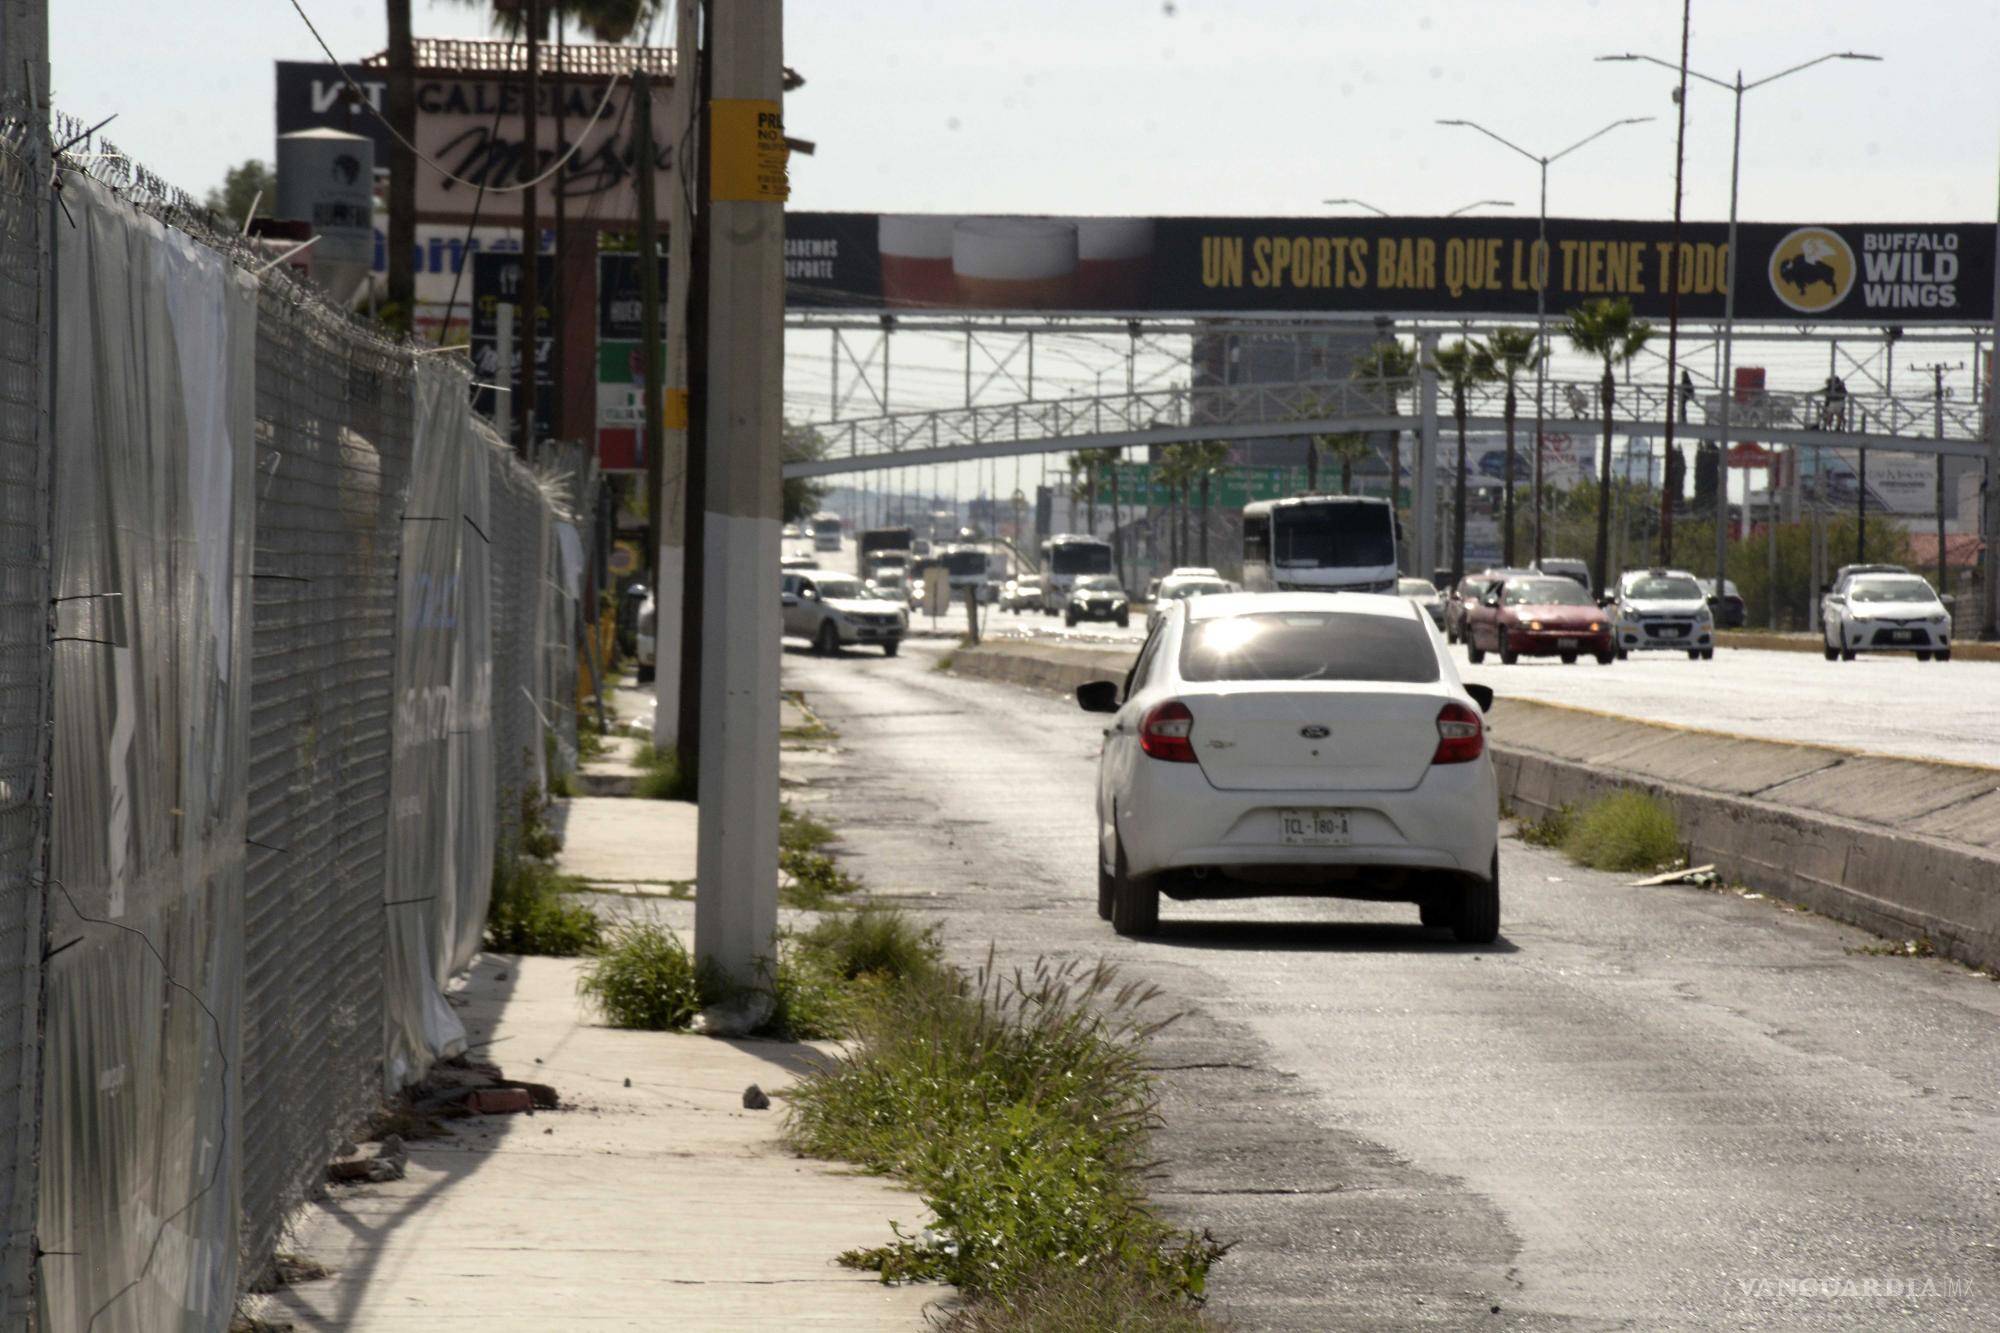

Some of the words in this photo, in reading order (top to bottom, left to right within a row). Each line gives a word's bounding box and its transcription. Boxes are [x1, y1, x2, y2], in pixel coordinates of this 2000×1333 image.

[1863, 232, 1959, 251] BUFFALO
[1202, 236, 1243, 287] UN
[1251, 236, 1368, 288] SPORTS
[1377, 238, 1436, 289] BAR
[1445, 237, 1503, 298] QUE
[1511, 239, 1549, 291] LO
[1560, 241, 1648, 293] TIENE
[1862, 252, 1959, 283] WILD
[1863, 283, 1957, 308] WINGS
